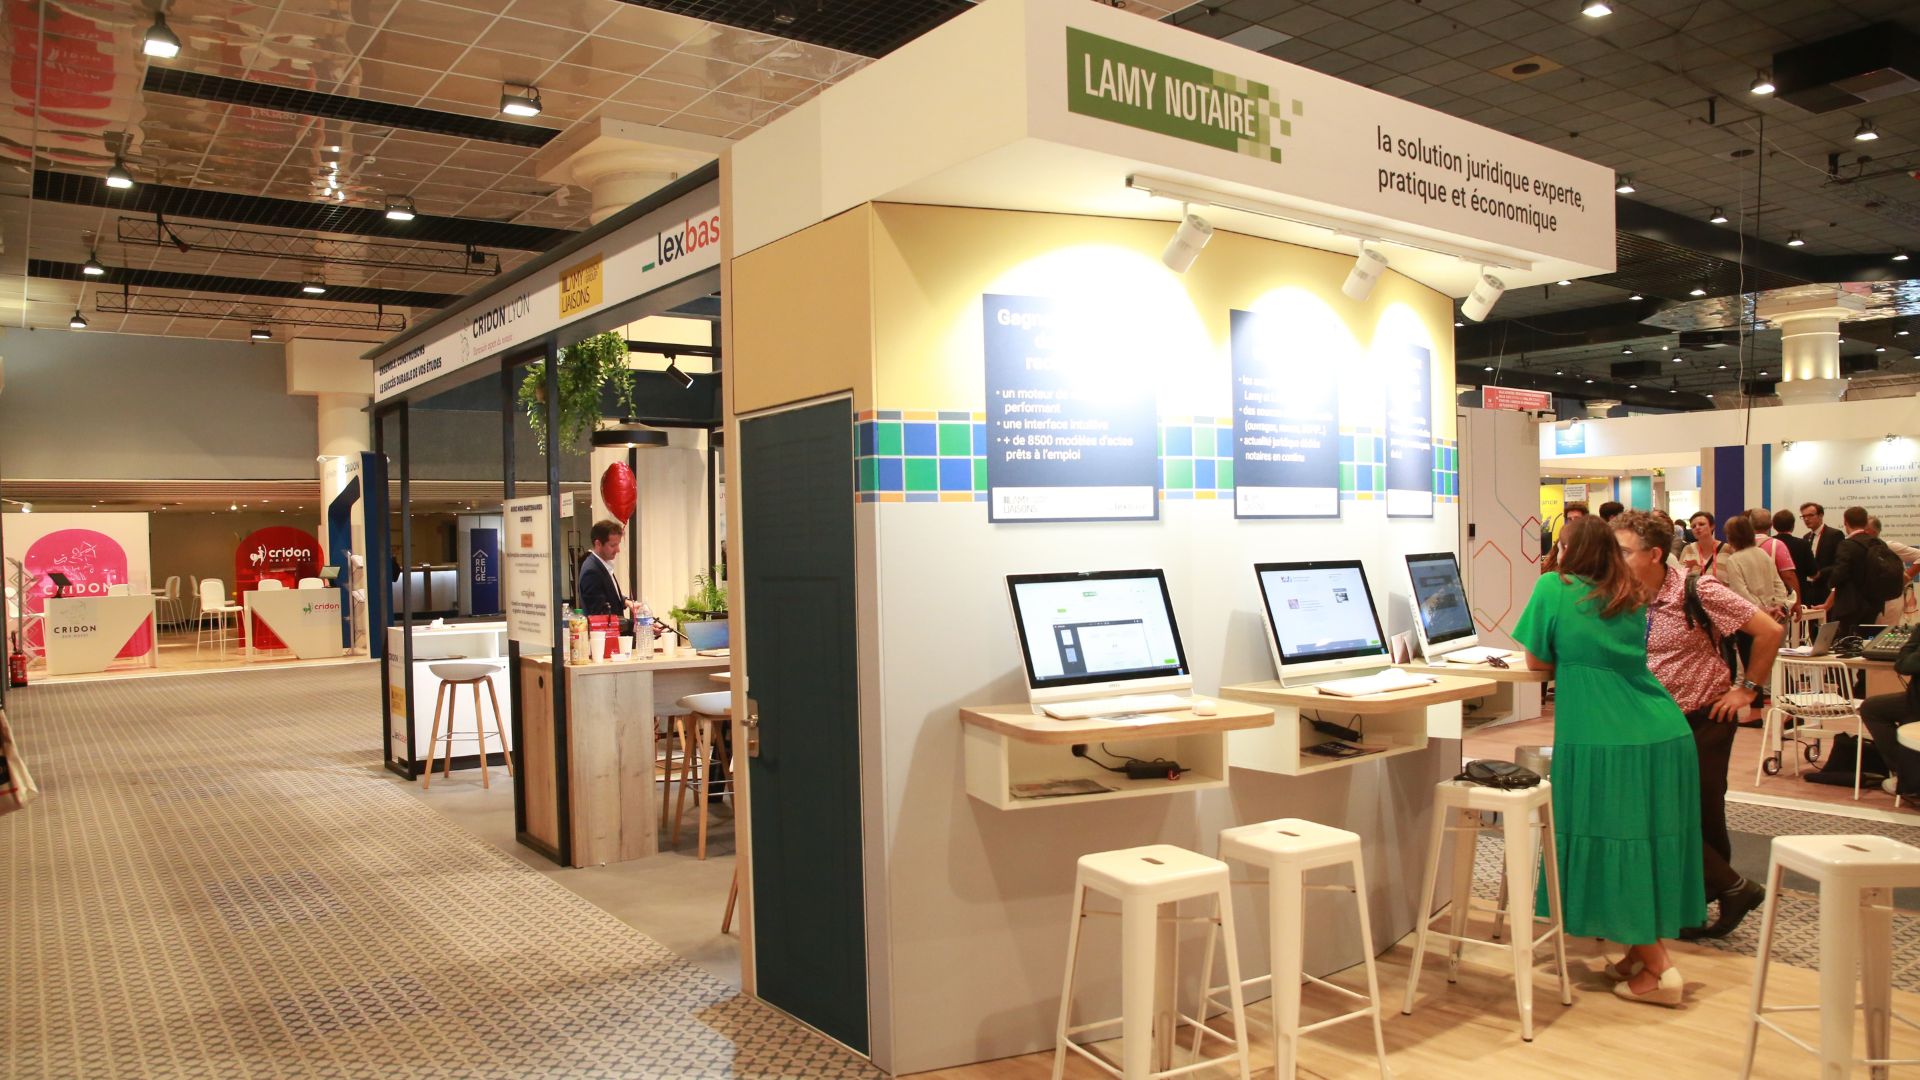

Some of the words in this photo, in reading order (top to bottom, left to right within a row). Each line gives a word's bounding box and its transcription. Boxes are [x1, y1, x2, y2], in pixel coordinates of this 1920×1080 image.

[1084, 53, 1157, 110] LAMY
[1165, 76, 1256, 137] NOTAIRE
[1377, 125, 1392, 153] la
[1397, 137, 1462, 173] solution
[1466, 153, 1529, 194] juridique
[1533, 178, 1585, 212] experte,
[1378, 167, 1447, 204] pratique
[1451, 188, 1467, 208] et
[1471, 188, 1557, 234] économique
[657, 215, 720, 266] lexbas
[562, 286, 590, 313] LIAISONS
[472, 305, 505, 338] CRIDON
[508, 292, 530, 323] LYON
[379, 383, 384, 394] LE
[384, 375, 396, 392] SUCCÈS
[396, 369, 412, 386] DURABLE
[412, 367, 418, 379] DE
[418, 364, 426, 376] VOS
[426, 356, 442, 373] ÉTUDES
[1002, 389, 1015, 399] un
[1004, 401, 1061, 415] performant
[1003, 421, 1023, 430] une
[1024, 419, 1068, 430] interface
[1013, 435, 1026, 446] de
[1028, 435, 1052, 446] 8500
[1006, 449, 1032, 462] prêts
[1034, 448, 1041, 460] à
[1042, 448, 1081, 462] l'emploi
[1860, 464, 1872, 472] La
[1875, 463, 1905, 472] raison
[1823, 477, 1835, 486] du
[1837, 476, 1870, 485] Conseil
[1873, 475, 1918, 486] supérieur
[268, 547, 310, 558] cridon
[314, 602, 340, 610] cridon
[53, 625, 97, 634] CRIDON
